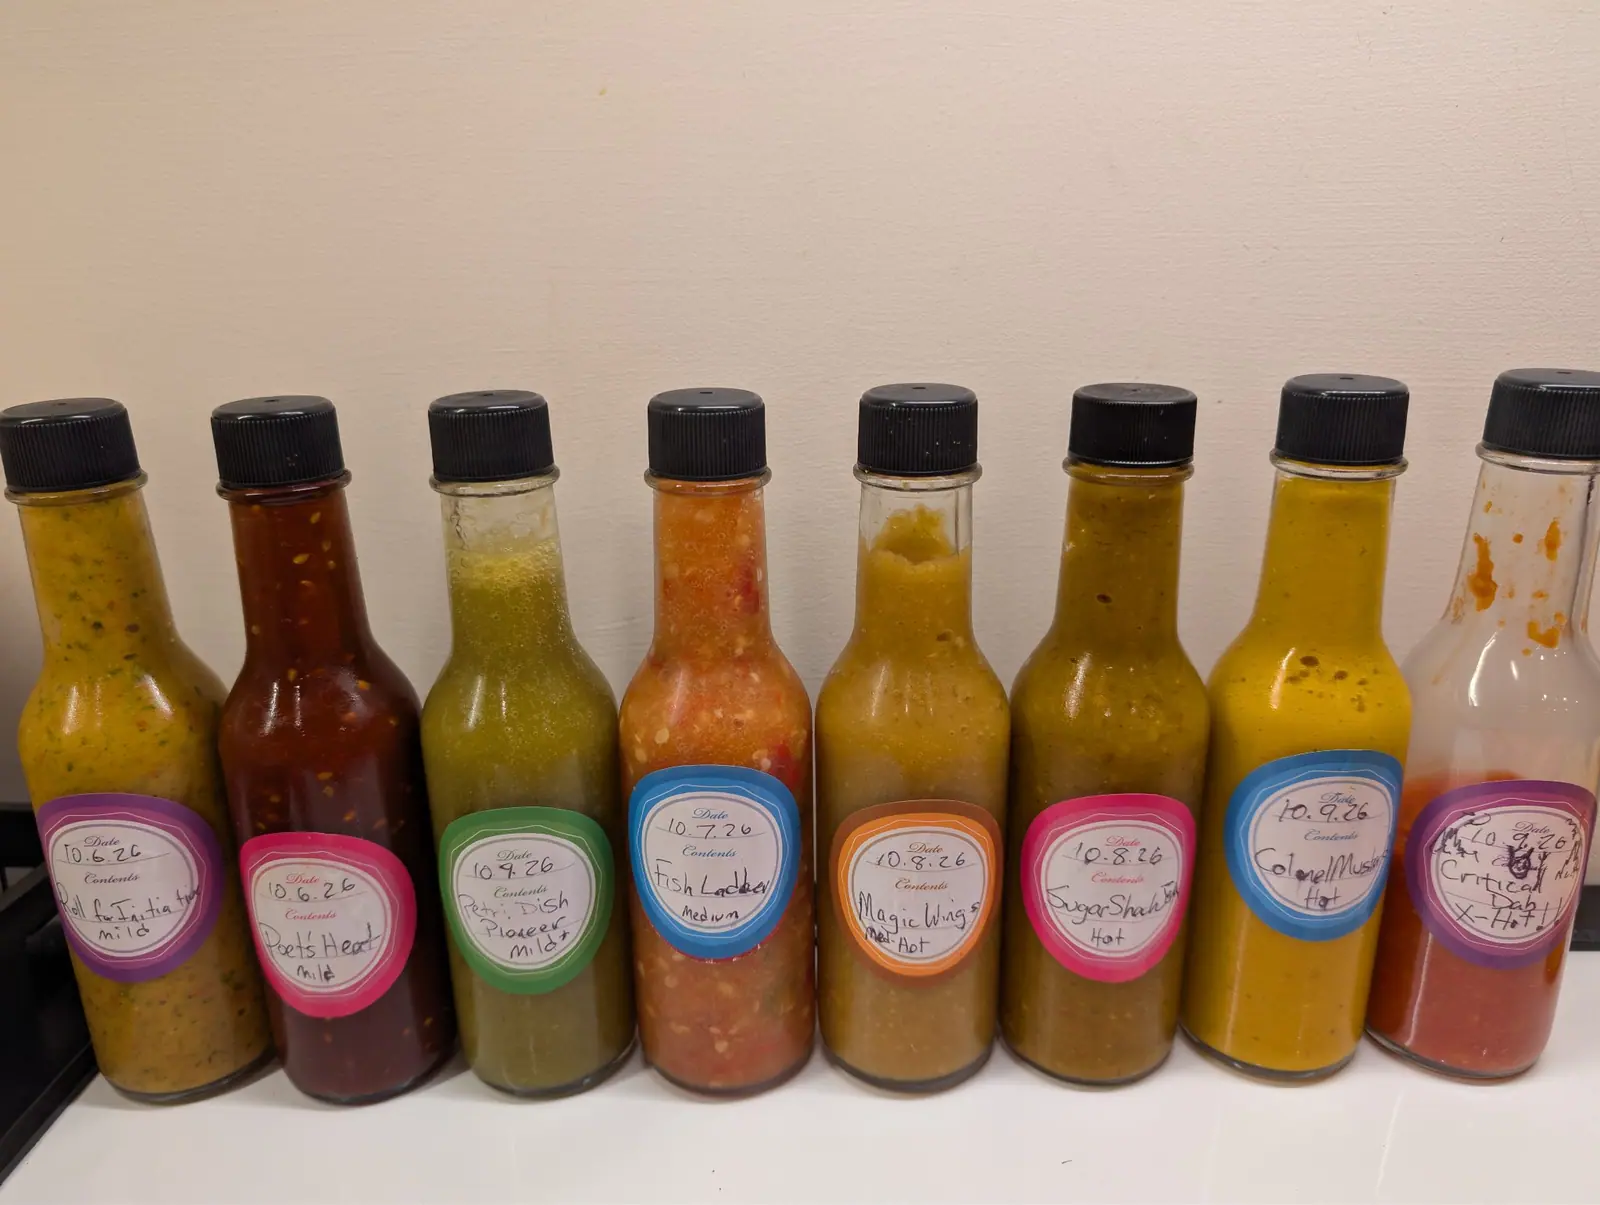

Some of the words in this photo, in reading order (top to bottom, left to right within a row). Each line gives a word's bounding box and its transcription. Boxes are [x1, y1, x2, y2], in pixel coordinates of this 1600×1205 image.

[1318, 791, 1356, 804] Date
[692, 807, 729, 820] Date
[1279, 799, 1369, 822] 10.9.26
[668, 818, 752, 840] 10.7.26
[1304, 828, 1359, 842] Contents
[1512, 821, 1551, 834] Date
[84, 836, 121, 848] Date
[906, 842, 944, 854] Date
[1105, 835, 1141, 847] Date
[64, 844, 142, 863] 10.6.26
[496, 849, 533, 862] Date
[682, 844, 738, 857] Contents
[1075, 842, 1163, 866] 10.8.26
[876, 851, 966, 871] 10.8.26
[84, 871, 140, 884] Contents
[286, 873, 320, 885] Date
[654, 859, 693, 897] Fish
[895, 877, 949, 891] Contents
[1091, 871, 1144, 884] Contents
[268, 878, 356, 902] 10.6.26
[494, 884, 548, 899] Contents
[514, 890, 569, 915] Dish
[1304, 886, 1341, 911] Hot
[1491, 894, 1537, 911] Dab
[94, 898, 114, 922] for
[285, 908, 337, 921] Contents
[858, 891, 920, 934] Magic
[924, 898, 981, 930] Wings
[259, 922, 316, 959] Poet's
[1090, 927, 1125, 948] Hot
